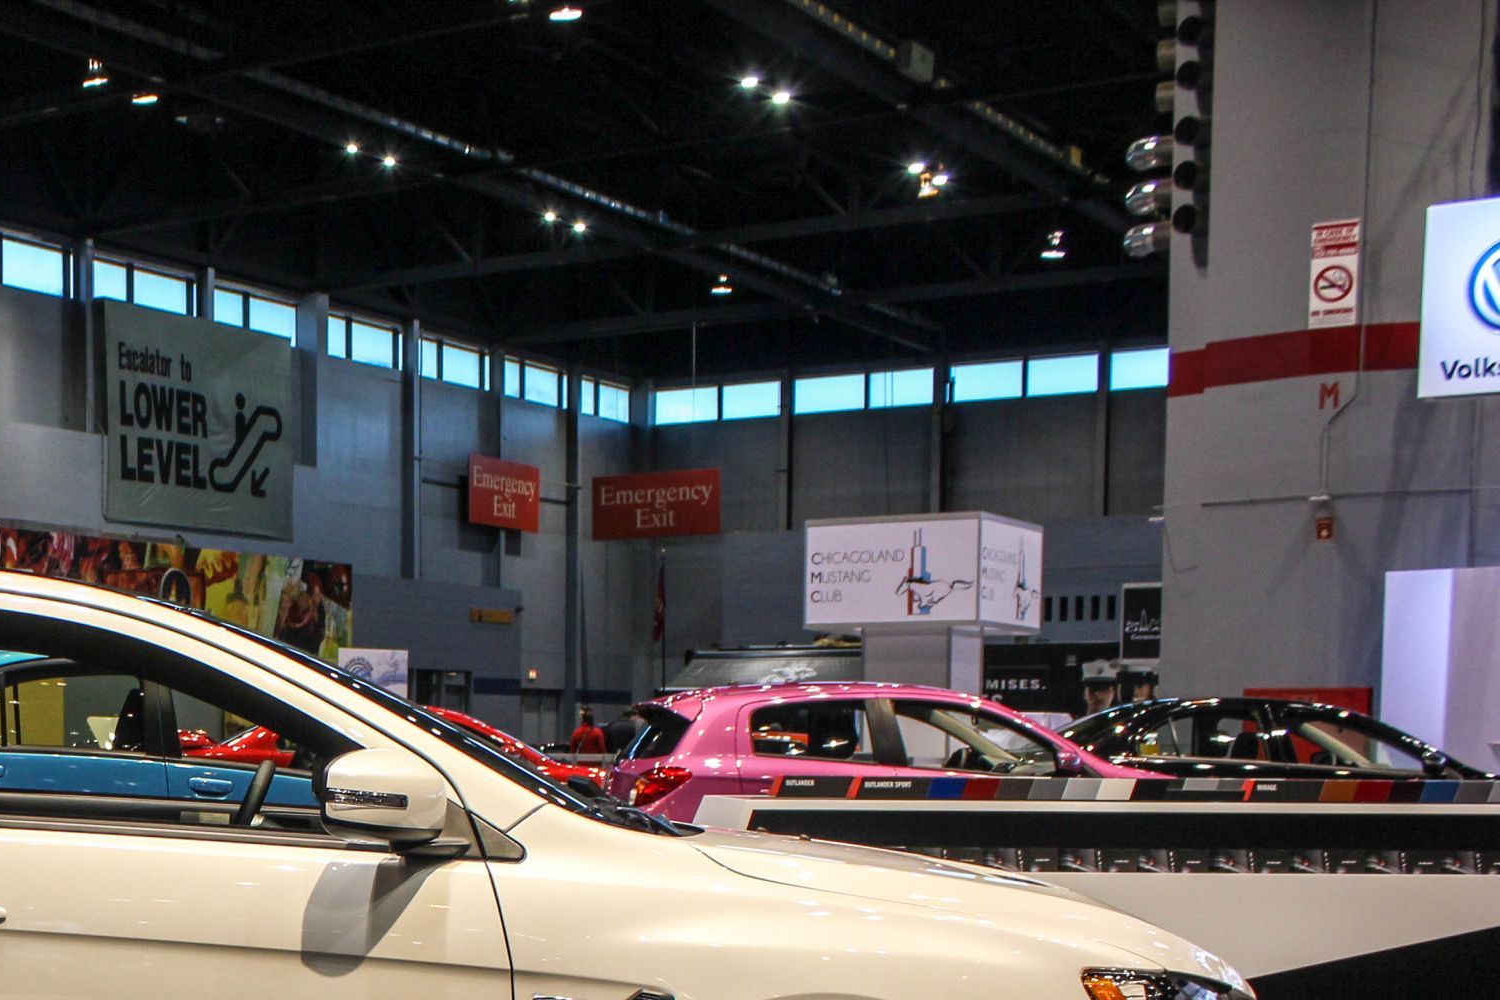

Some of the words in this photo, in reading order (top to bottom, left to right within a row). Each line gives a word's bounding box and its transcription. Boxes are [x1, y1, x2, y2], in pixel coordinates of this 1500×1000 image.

[118, 341, 172, 378] Escalator
[180, 353, 192, 382] to
[1319, 382, 1339, 410] M
[119, 380, 208, 438] LOWER
[120, 434, 207, 490] LEVEL
[473, 465, 536, 502] Emergency
[493, 495, 516, 519] Exit
[600, 484, 713, 509] Emergency
[636, 507, 675, 529] Exit
[811, 548, 905, 566] CHICAGOLAND
[810, 569, 871, 584] MUSTANG
[810, 589, 842, 603] CLUB
[785, 779, 815, 787] OUTLANDER
